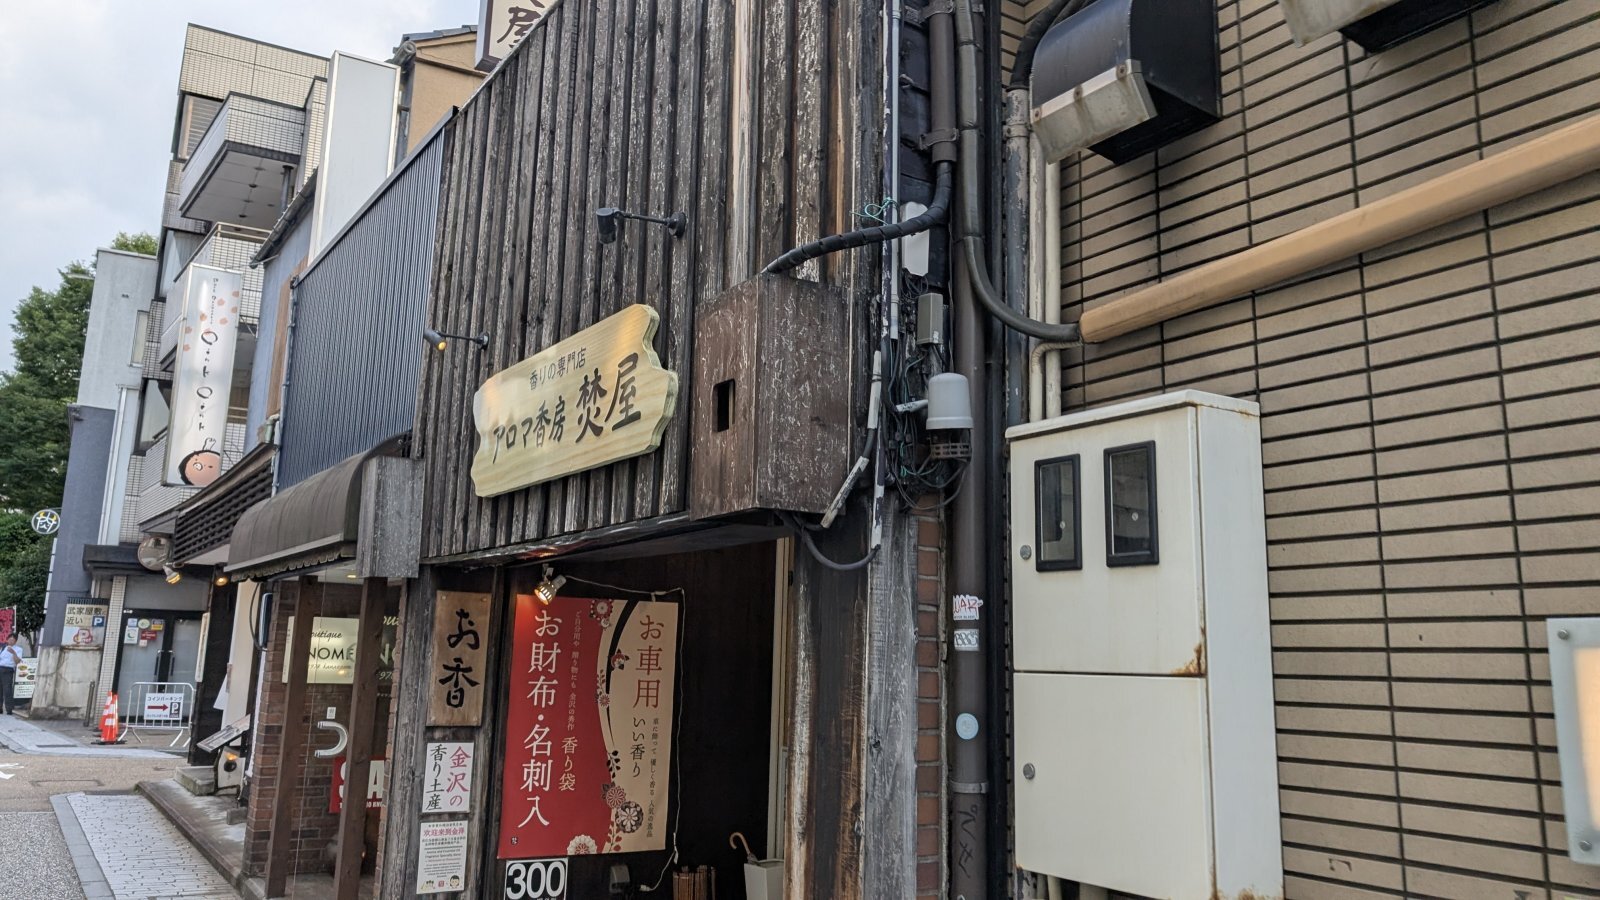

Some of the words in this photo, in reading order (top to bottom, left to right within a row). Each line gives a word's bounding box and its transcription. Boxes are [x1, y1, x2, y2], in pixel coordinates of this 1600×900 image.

[497, 0, 545, 48] 屋
[530, 347, 587, 391] 香りの専門店
[492, 395, 566, 464] アロマ香房
[575, 352, 642, 444] 焚屋
[66, 616, 83, 625] 近い
[94, 617, 103, 626] P
[311, 631, 343, 643] outique
[439, 608, 480, 708] お香
[633, 615, 664, 708] お車用
[518, 610, 562, 829] お財布・名刺入
[630, 716, 646, 777] いい香り
[426, 744, 447, 811] 香り土産
[446, 746, 471, 807] 金沢の
[558, 736, 578, 791] 香り袋
[507, 861, 565, 900] 300
